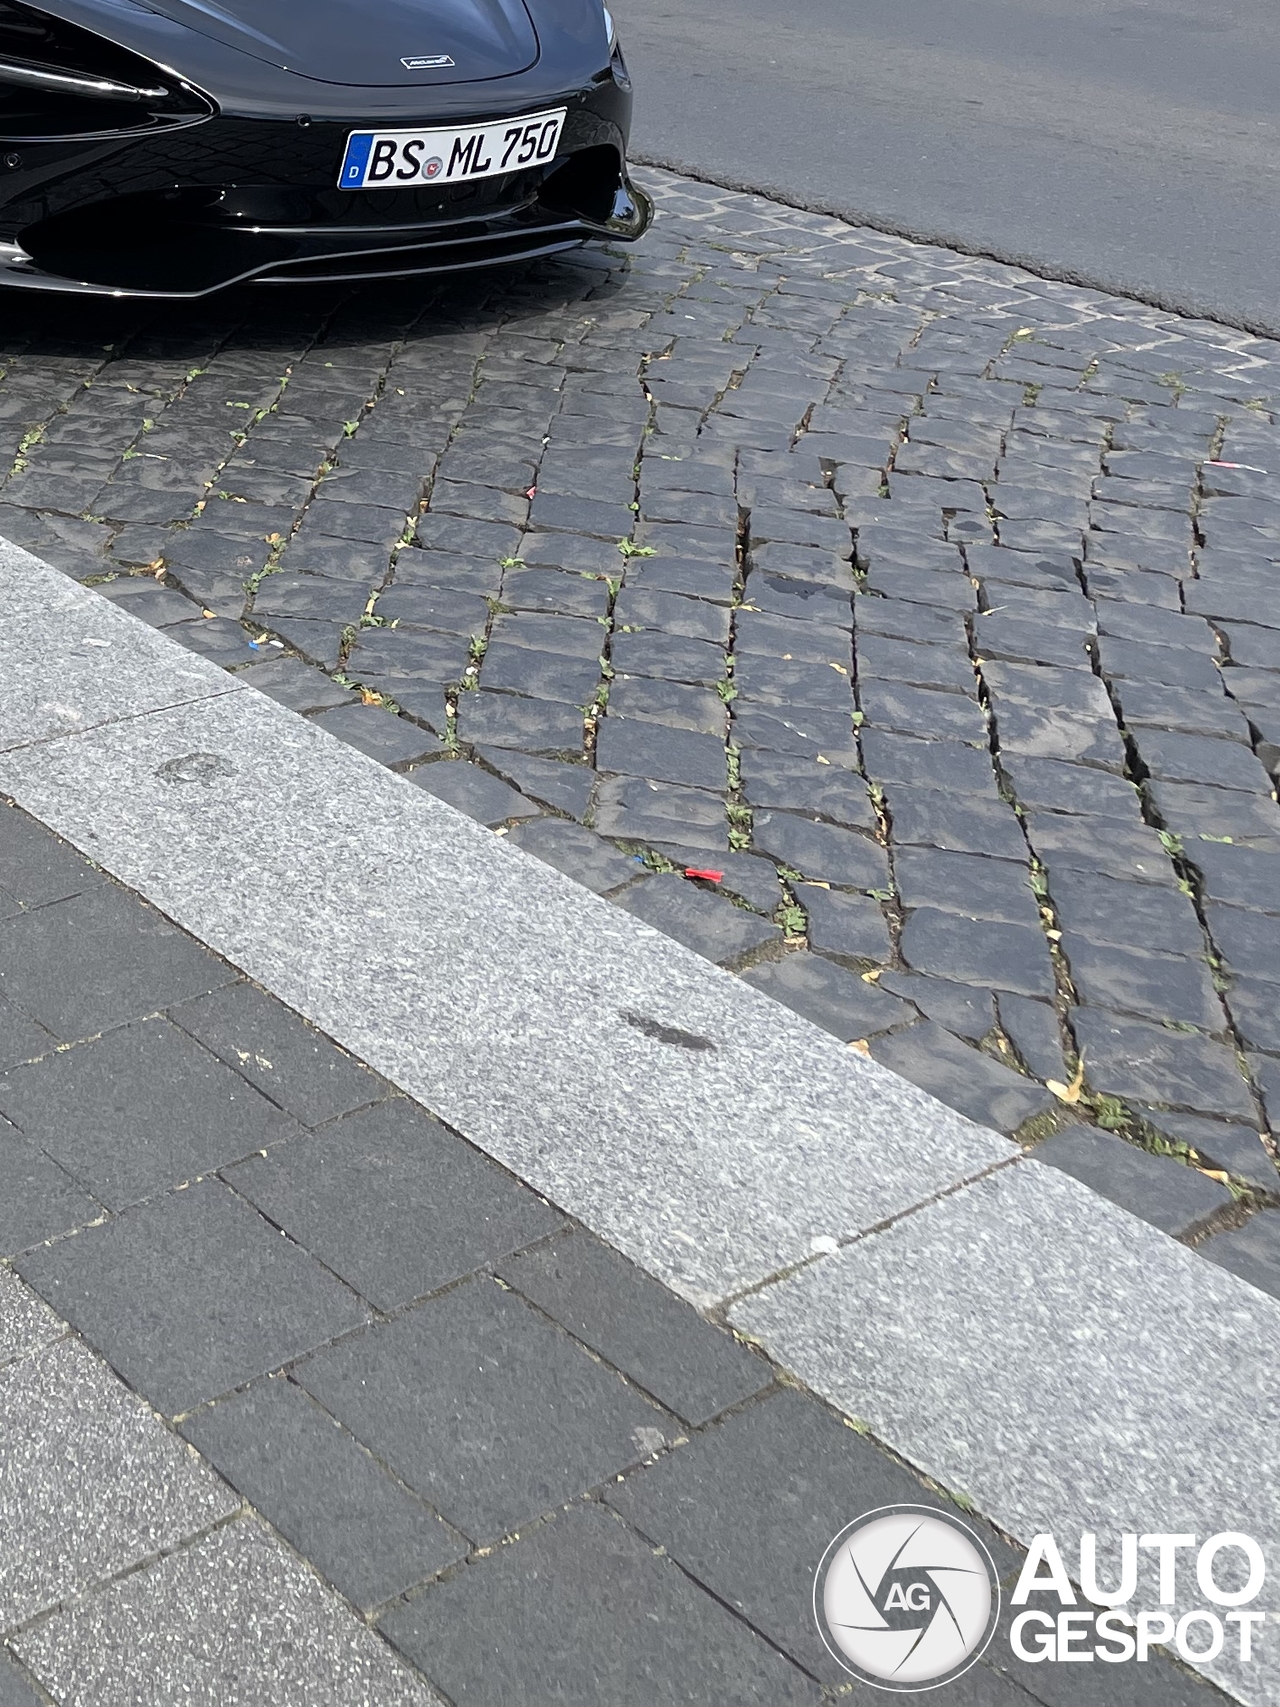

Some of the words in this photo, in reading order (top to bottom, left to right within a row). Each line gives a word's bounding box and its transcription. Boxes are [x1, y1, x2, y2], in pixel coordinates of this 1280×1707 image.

[348, 166, 360, 179] D
[367, 140, 426, 181] BS
[446, 134, 492, 178] ML
[500, 119, 559, 169] 750
